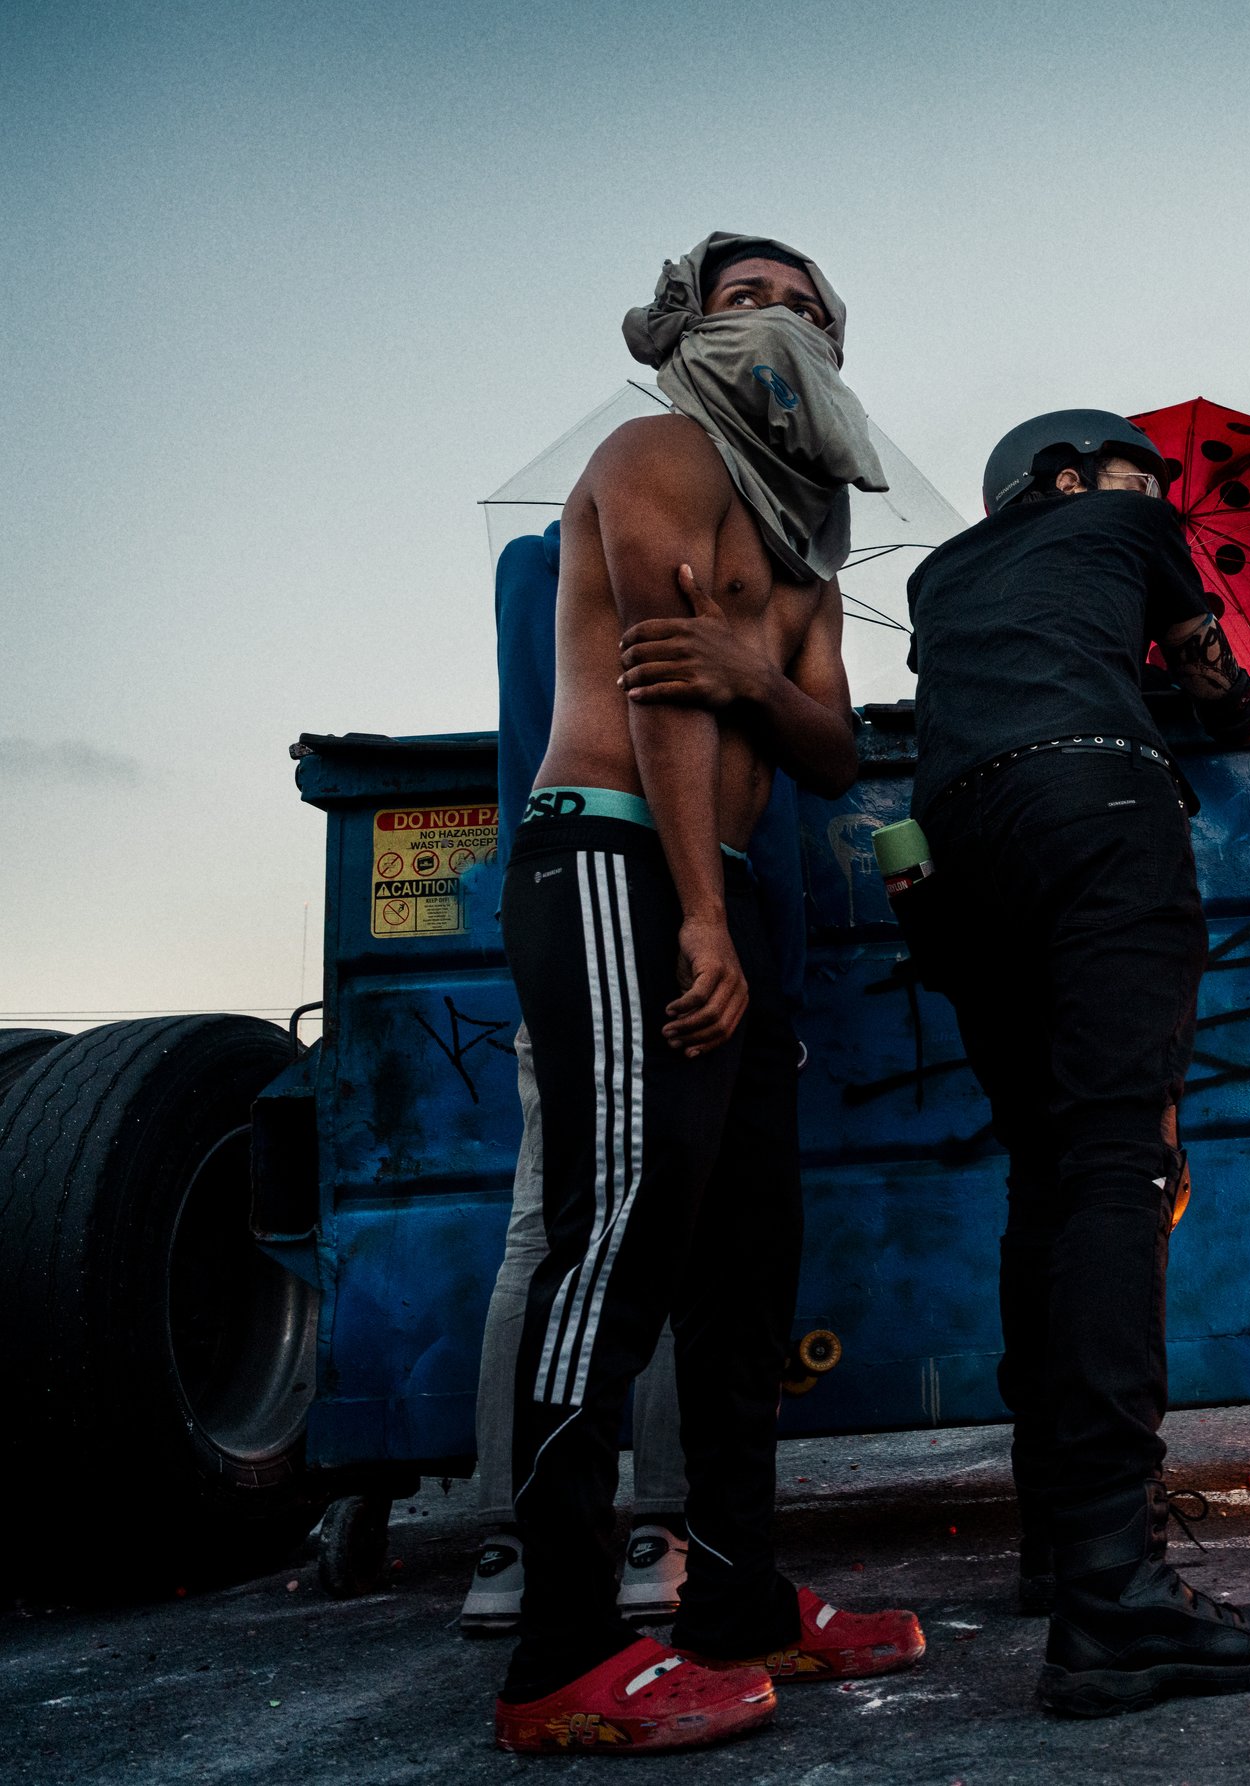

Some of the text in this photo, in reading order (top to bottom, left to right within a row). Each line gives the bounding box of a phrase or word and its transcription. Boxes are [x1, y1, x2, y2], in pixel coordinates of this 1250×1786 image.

[995, 478, 1020, 501] SCHWINN
[394, 812, 423, 830] DO
[430, 809, 472, 827] NOT
[420, 827, 498, 839] NO HAZARDOU
[391, 879, 458, 897] CAUTION
[766, 1649, 799, 1677] 95
[570, 1713, 600, 1745] 95
